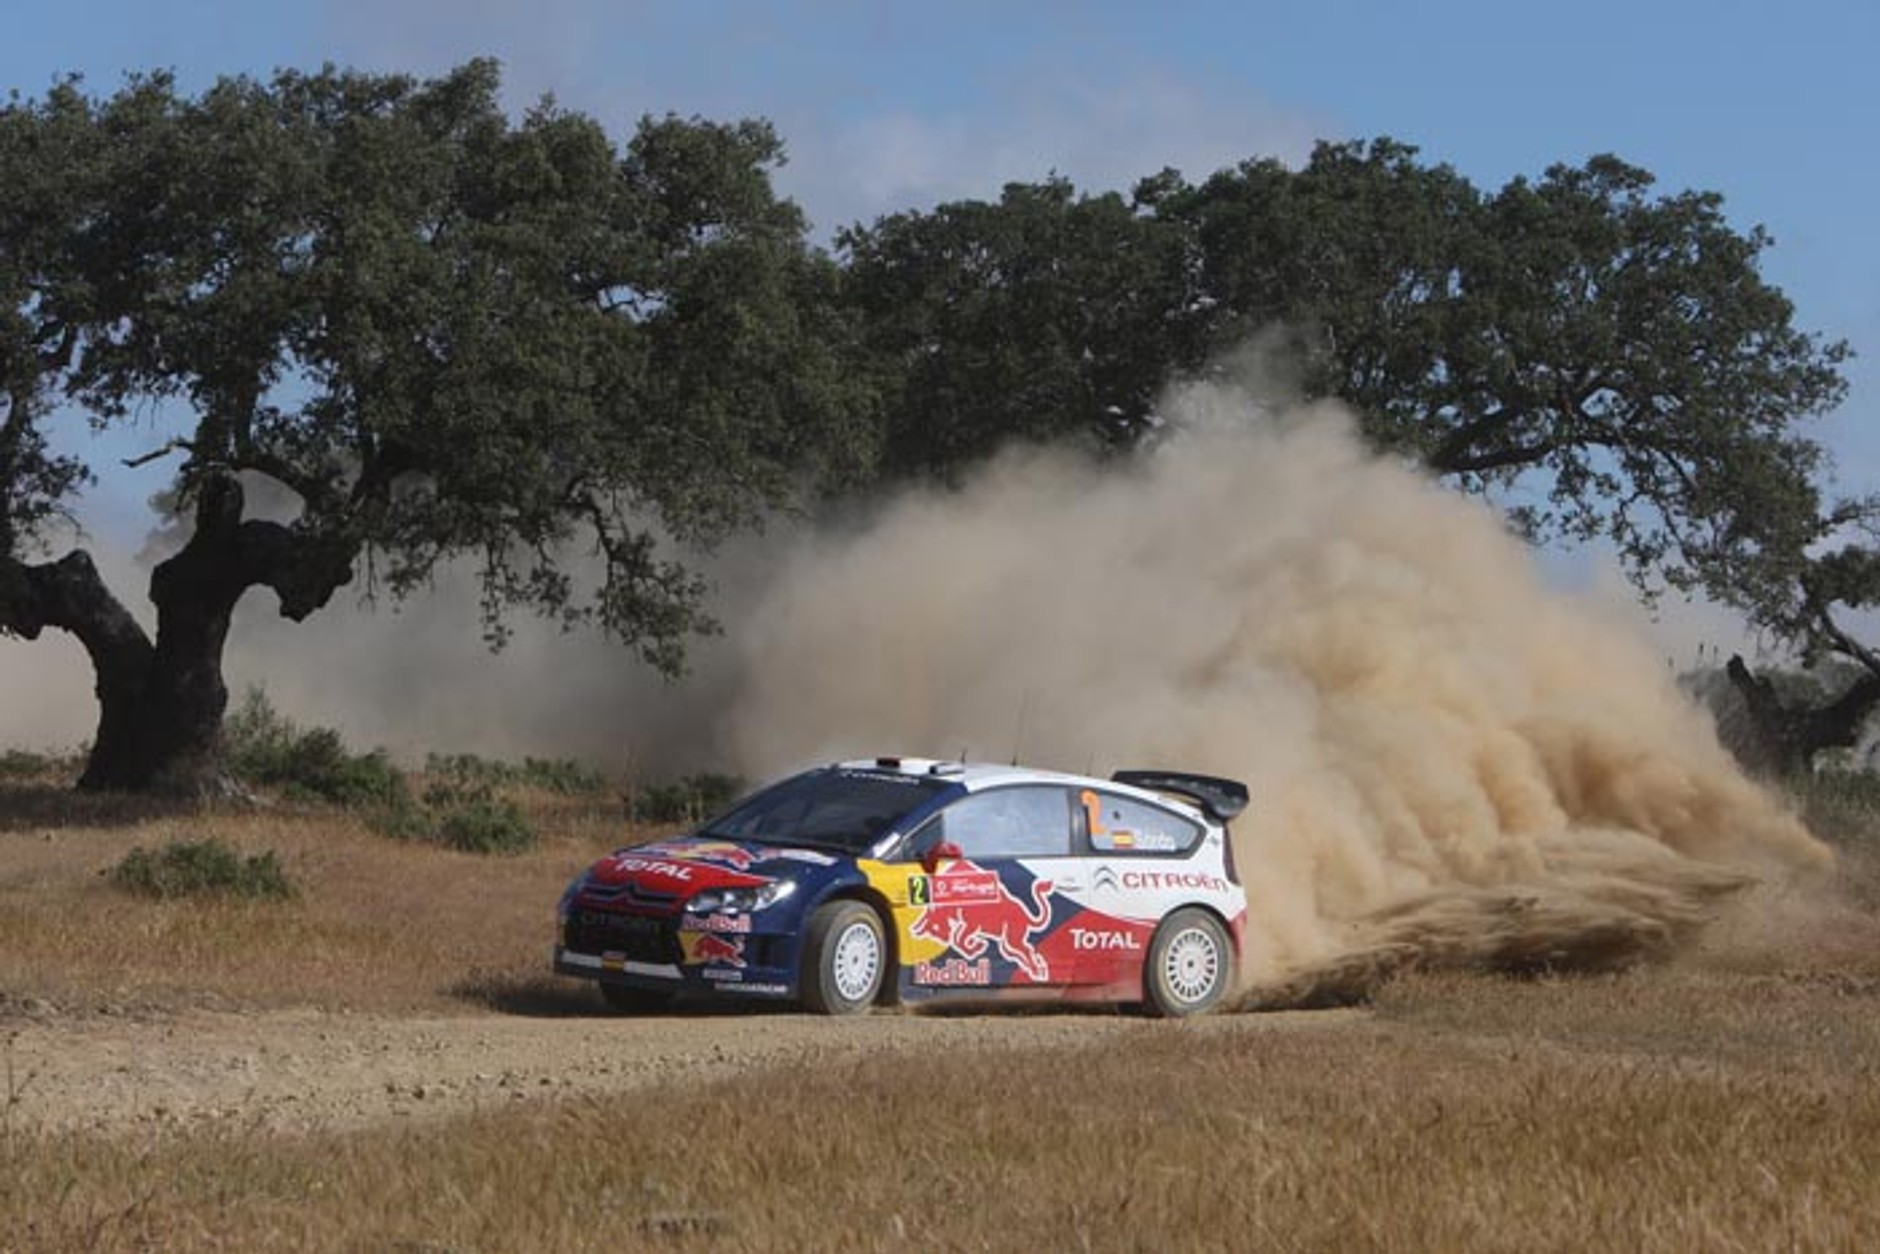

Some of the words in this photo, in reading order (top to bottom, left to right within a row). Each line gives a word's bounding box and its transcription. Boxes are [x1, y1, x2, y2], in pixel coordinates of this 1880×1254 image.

[614, 859, 691, 880] TOTAL
[912, 876, 924, 903] 2
[1069, 928, 1140, 949] TOTAL
[914, 960, 952, 984] Red
[952, 958, 990, 984] Bull
